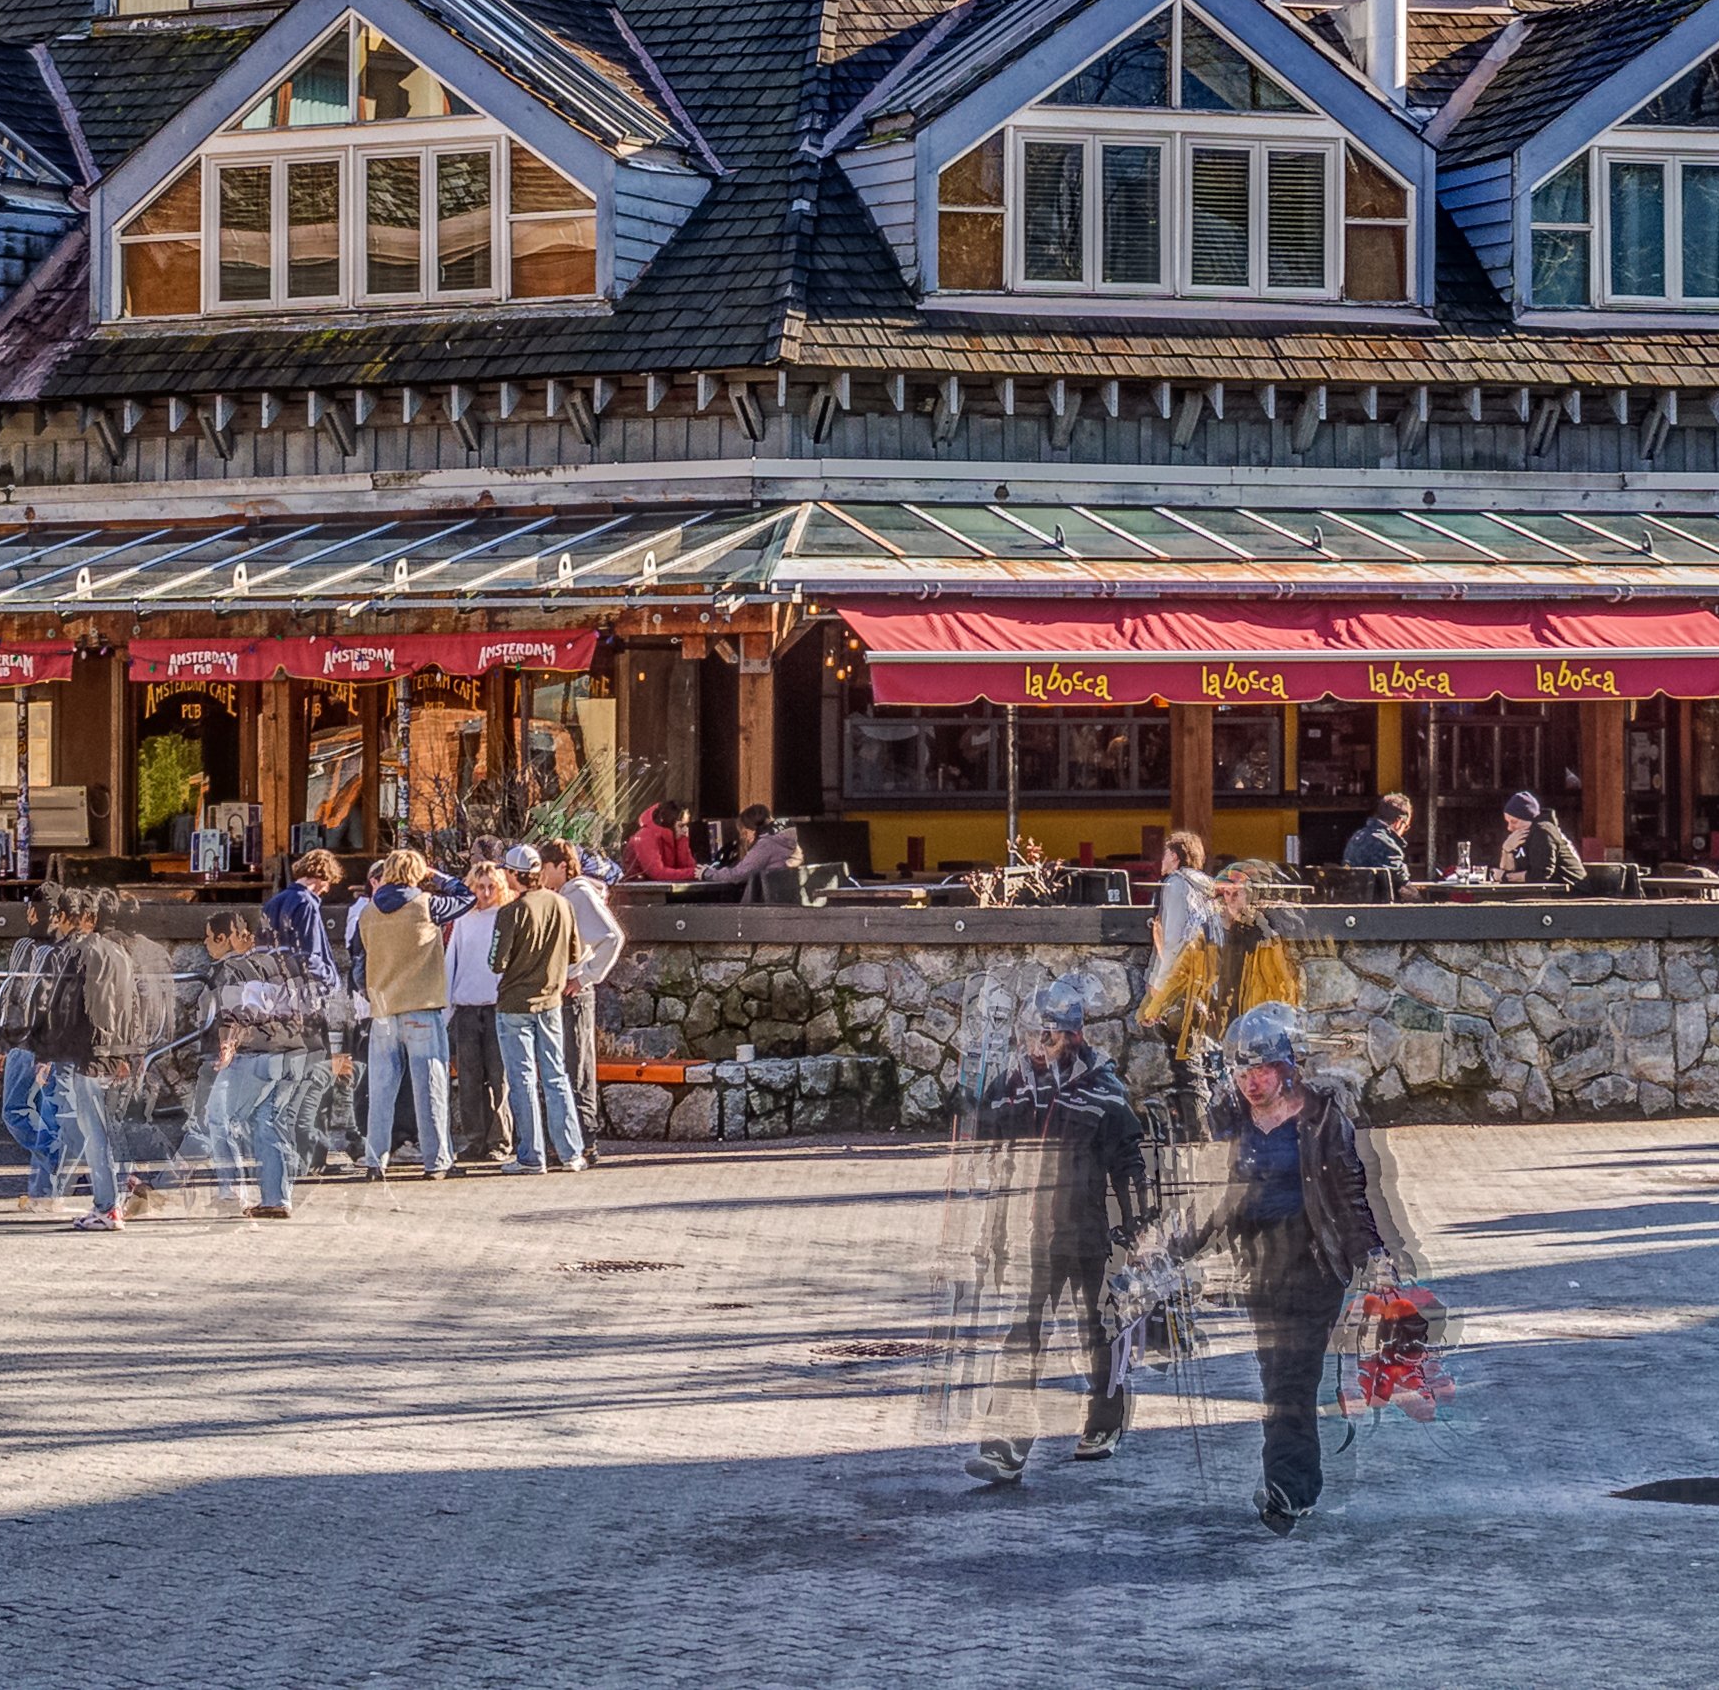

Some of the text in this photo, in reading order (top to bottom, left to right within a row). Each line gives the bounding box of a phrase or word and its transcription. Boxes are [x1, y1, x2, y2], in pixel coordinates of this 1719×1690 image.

[167, 650, 238, 676] AMSTERDAM
[322, 647, 396, 674] AMSTERDAM
[351, 661, 370, 671] PUB
[478, 642, 555, 670] AMSTERDAM
[193, 664, 213, 675] PUB
[182, 703, 201, 718] PUB
[209, 682, 237, 718] CAFE
